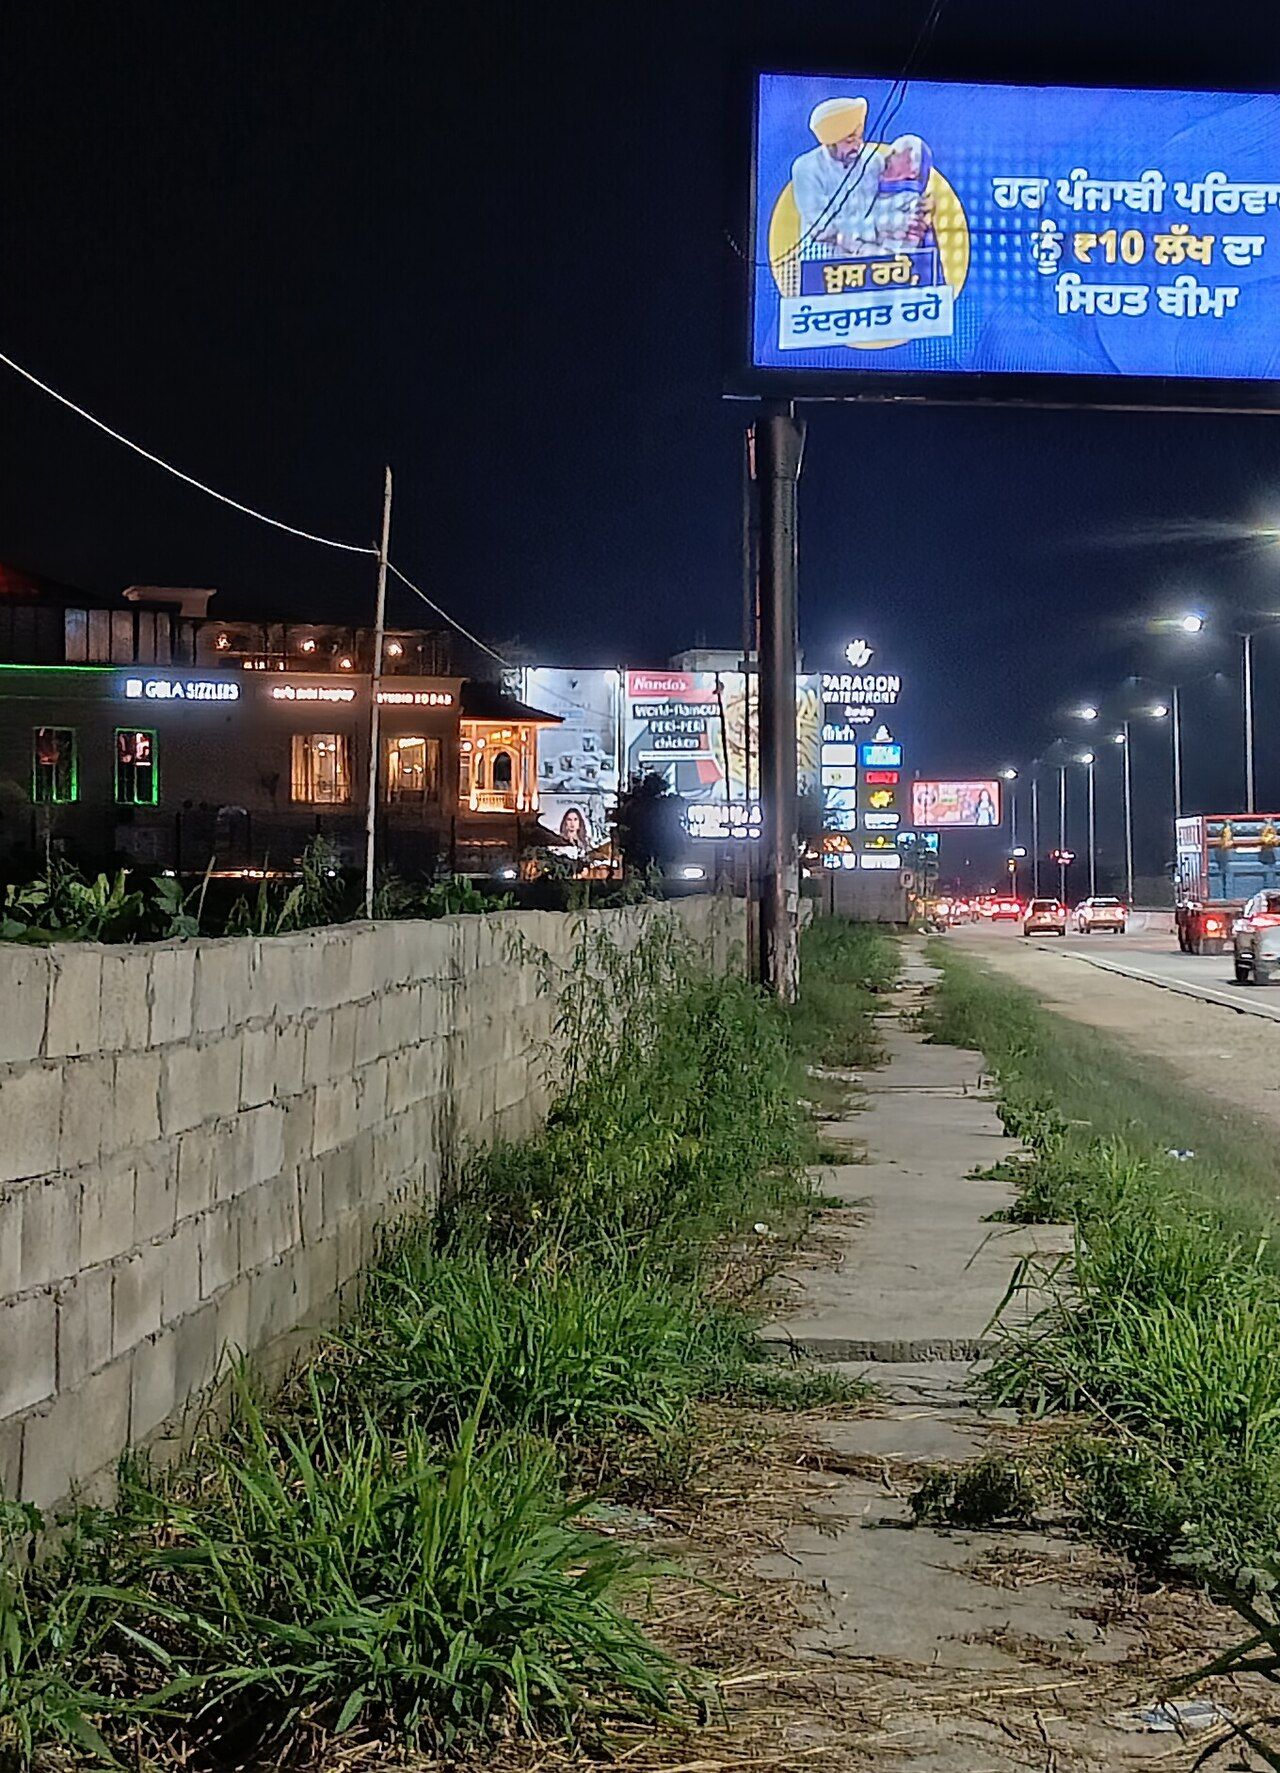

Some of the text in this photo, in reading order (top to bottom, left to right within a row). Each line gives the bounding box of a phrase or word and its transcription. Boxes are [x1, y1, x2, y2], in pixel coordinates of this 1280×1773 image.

[992, 177, 1049, 209] ਹਰ
[1056, 168, 1167, 213] ਪੰਜਾਬੀ
[1073, 229, 1145, 265] ₹10
[1153, 223, 1216, 266] ਲੱਖ
[1222, 234, 1266, 266] ਦਾ
[792, 293, 942, 336] ਤੰਦਰੁਸਤ ਰਹੋ
[1055, 272, 1240, 318] ਸਿਹਤ ਬੀਮਾ
[633, 675, 687, 692] Nando's
[822, 674, 900, 692] PARAGON
